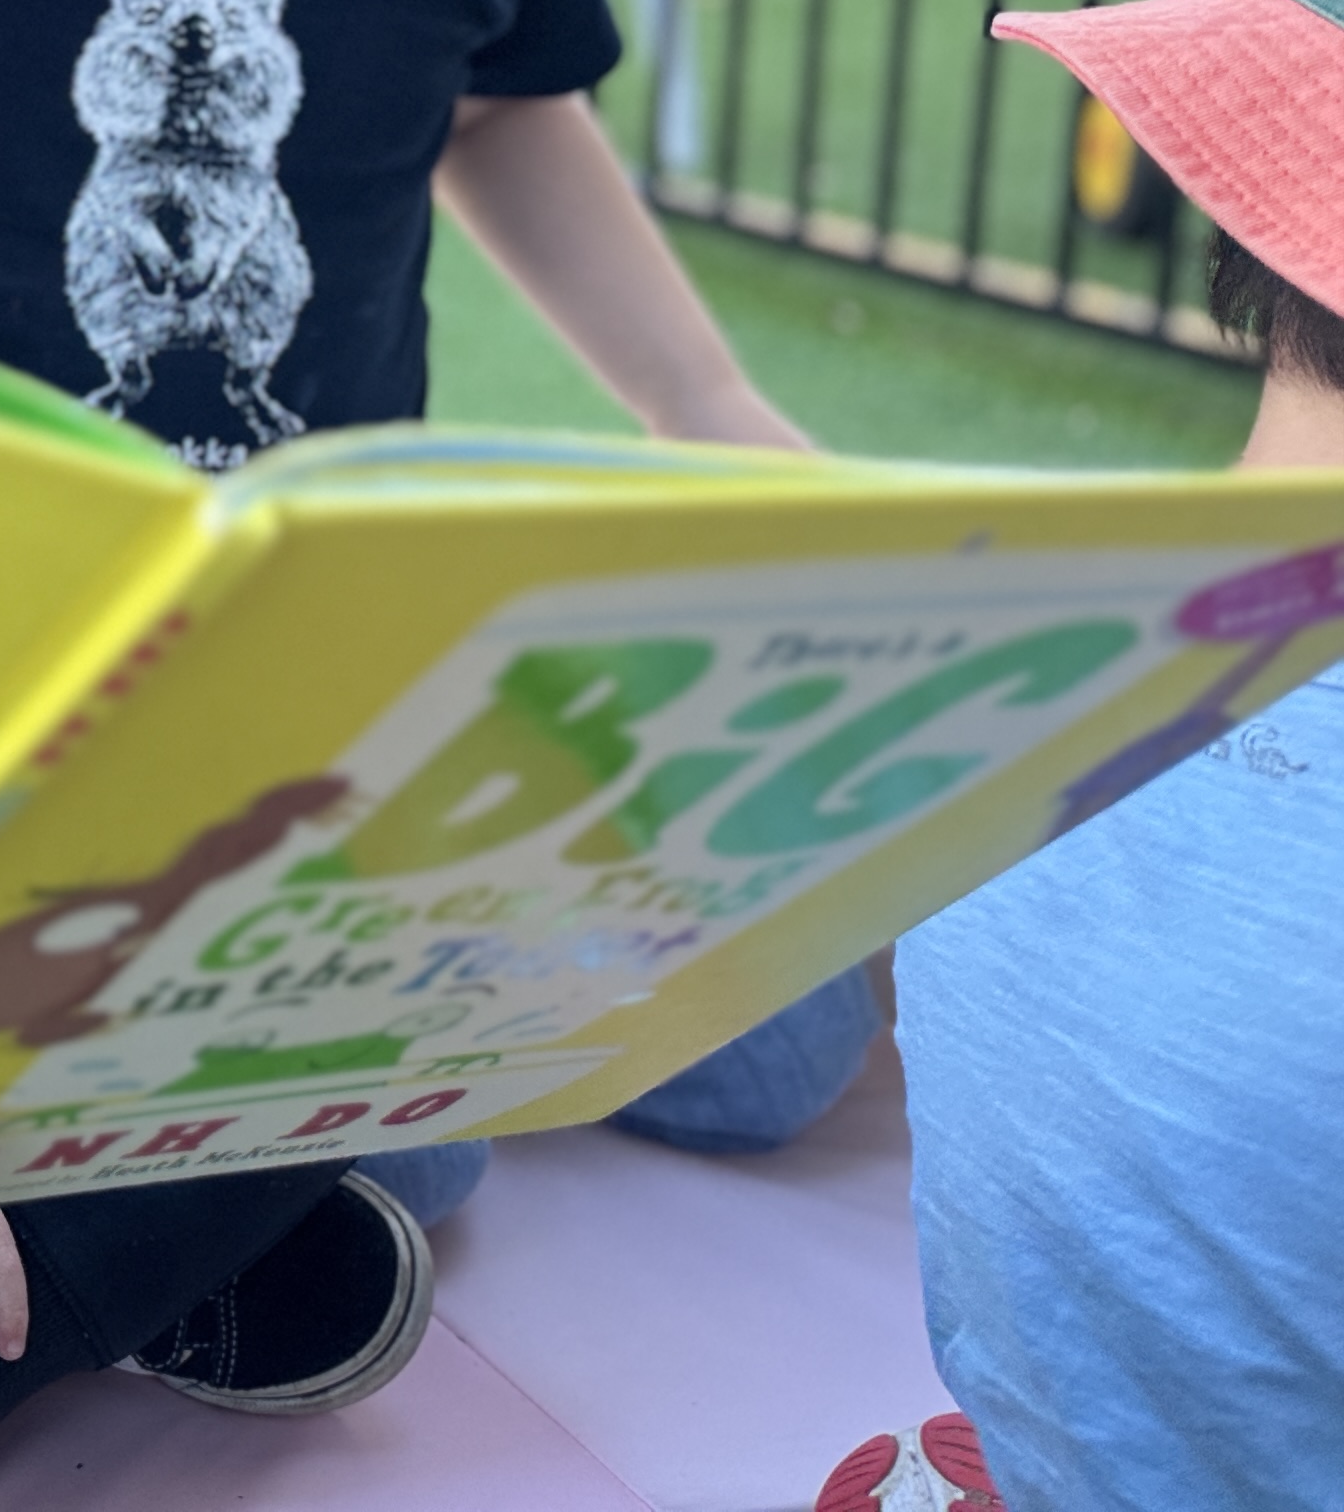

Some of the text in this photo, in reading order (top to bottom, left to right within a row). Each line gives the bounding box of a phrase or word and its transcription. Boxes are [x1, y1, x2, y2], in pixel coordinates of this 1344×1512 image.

[130, 976, 225, 1019] in
[253, 946, 397, 998] the
[274, 1088, 469, 1141] DO
